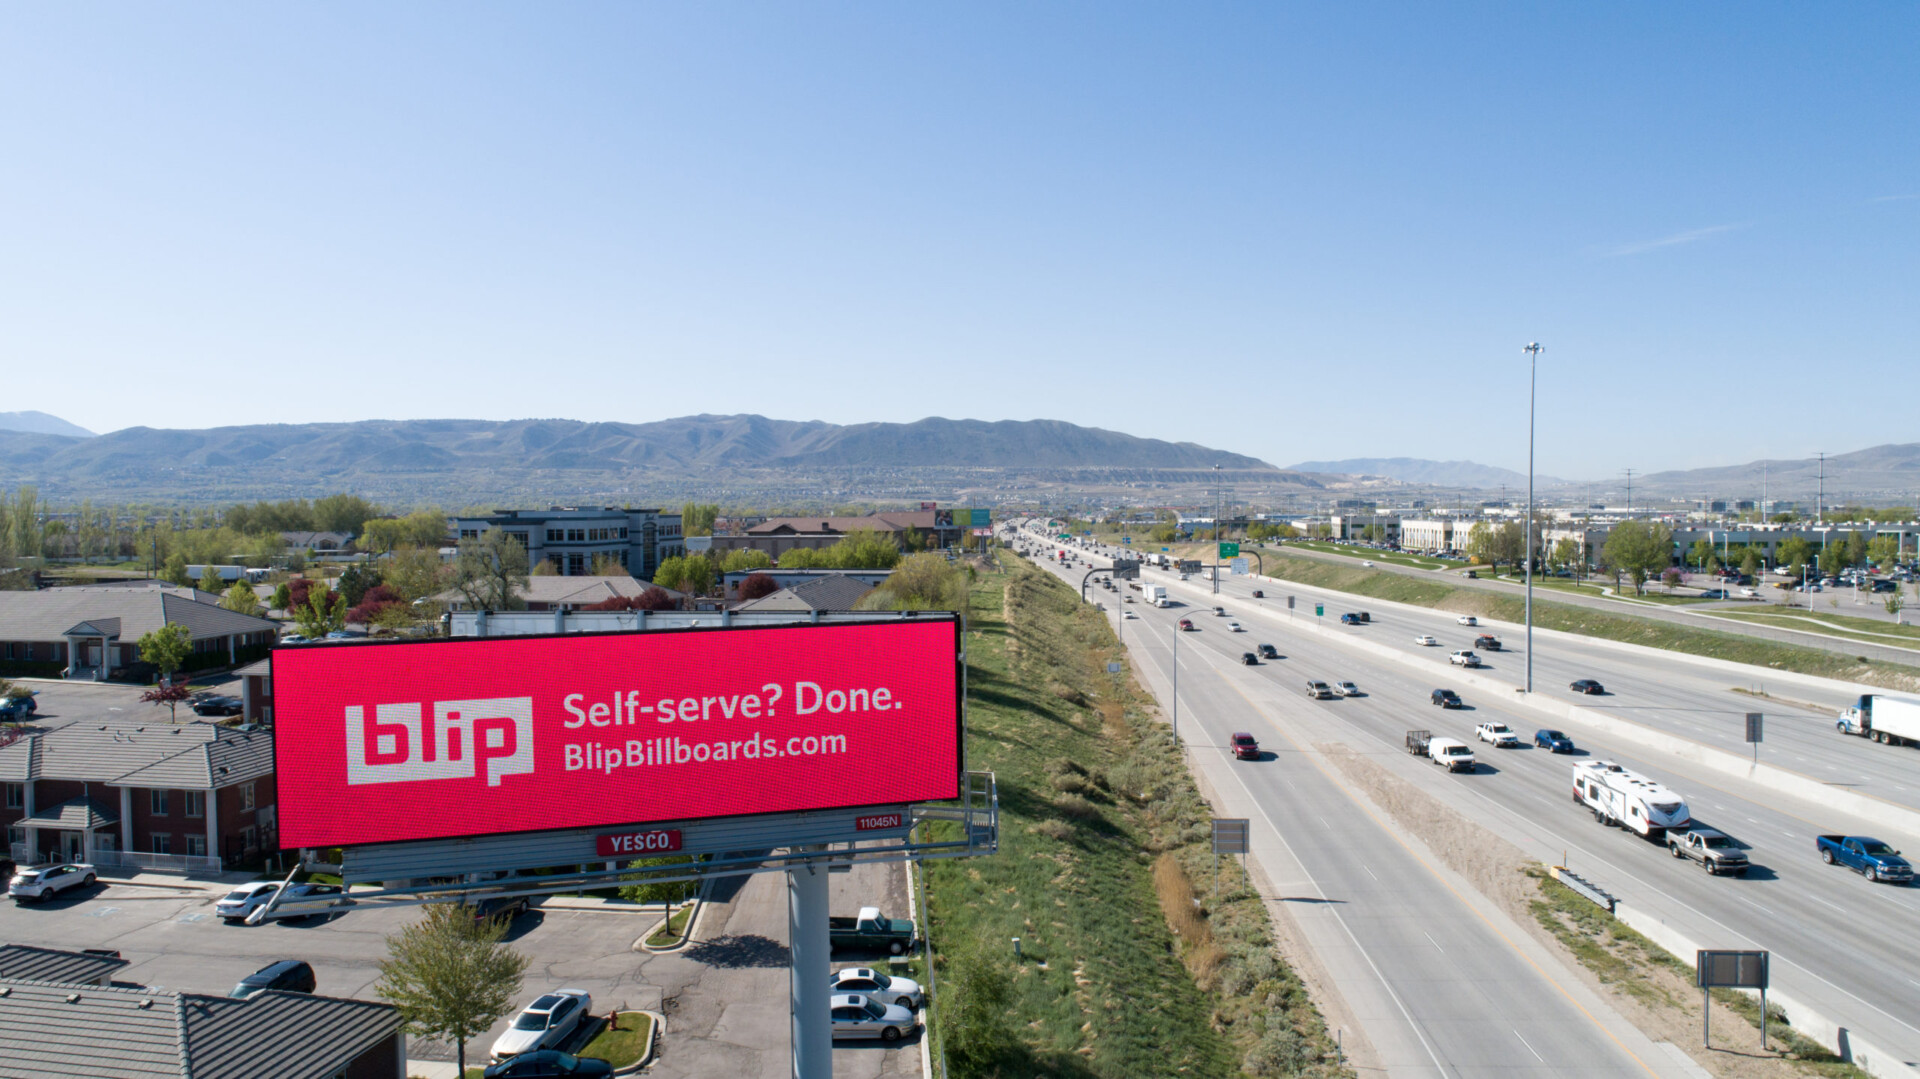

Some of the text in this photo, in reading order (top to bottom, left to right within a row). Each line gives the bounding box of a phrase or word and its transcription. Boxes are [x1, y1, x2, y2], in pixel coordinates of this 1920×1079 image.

[563, 681, 903, 729] Self-serve? Done.
[360, 700, 520, 787] blip
[564, 731, 847, 775] BlipBillboards.com
[860, 815, 898, 829] 11045N
